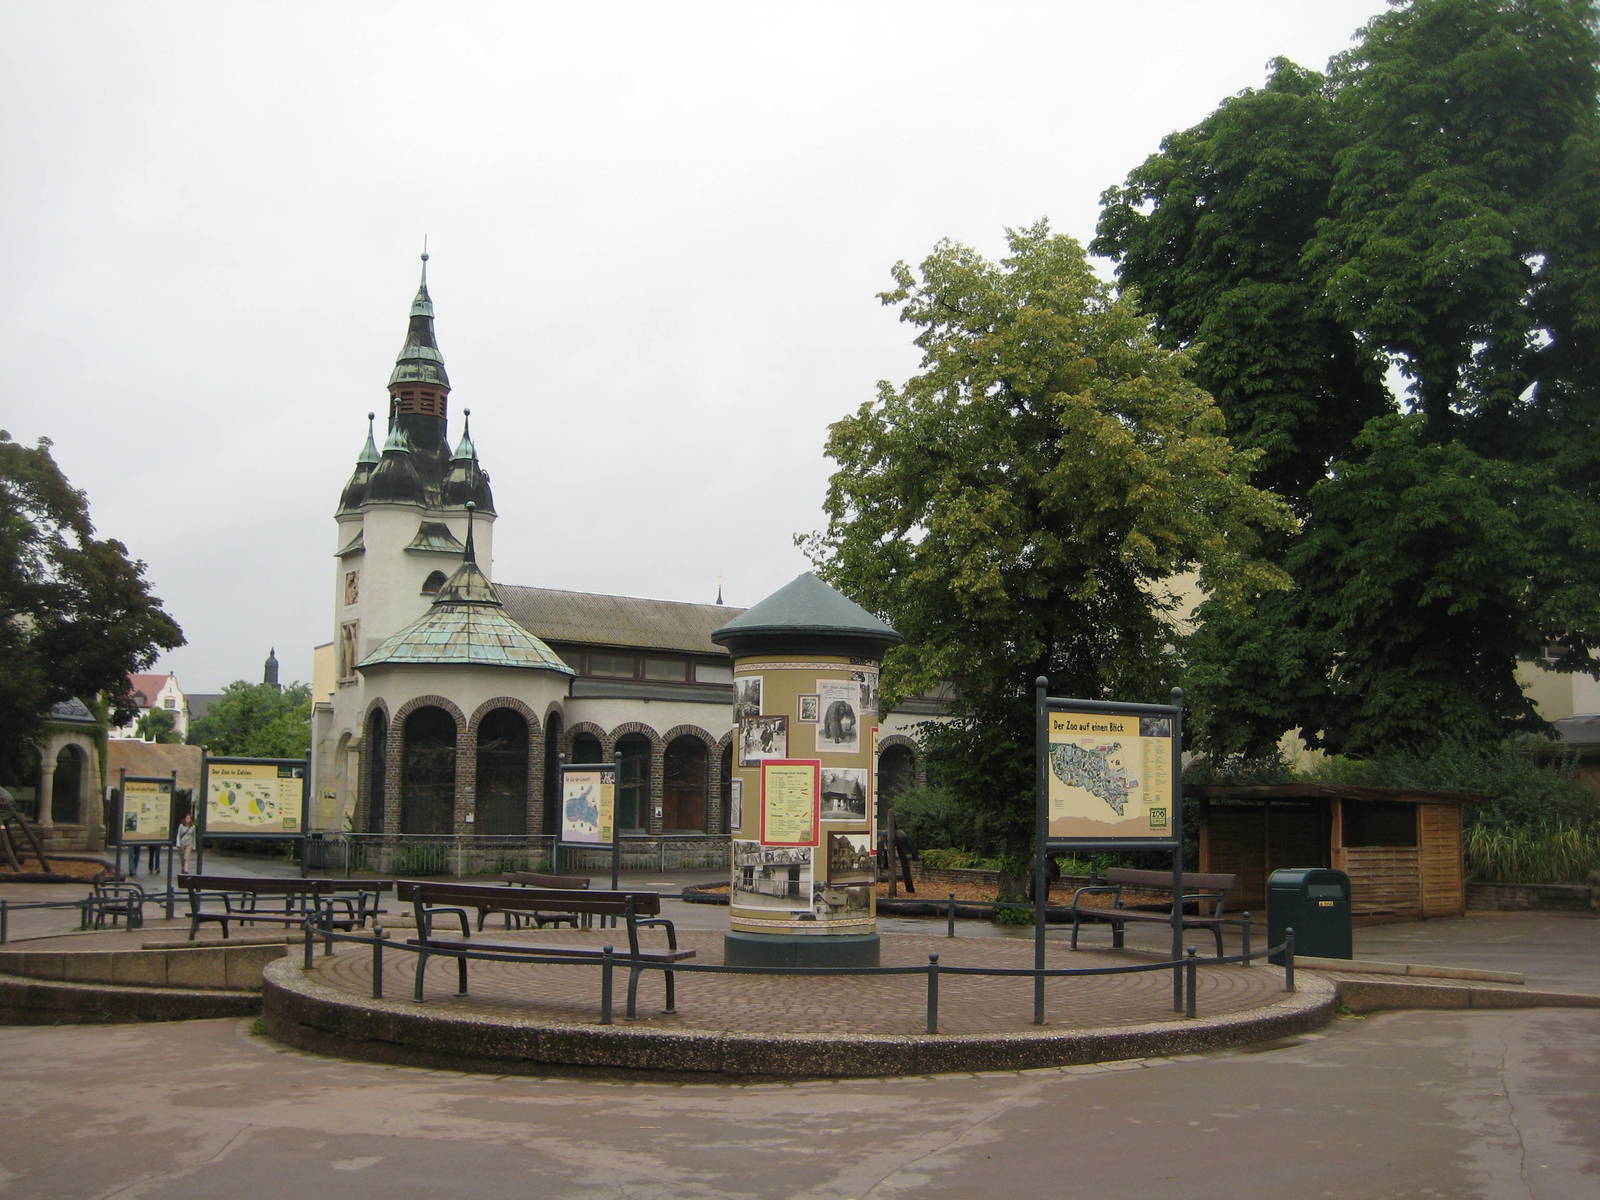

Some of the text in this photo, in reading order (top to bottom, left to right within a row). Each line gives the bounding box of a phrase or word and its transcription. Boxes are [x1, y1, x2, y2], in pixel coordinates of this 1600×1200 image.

[1054, 720, 1064, 730] Der
[1066, 720, 1078, 730] Zoo
[1079, 722, 1090, 731] auf
[1091, 722, 1108, 731] einen
